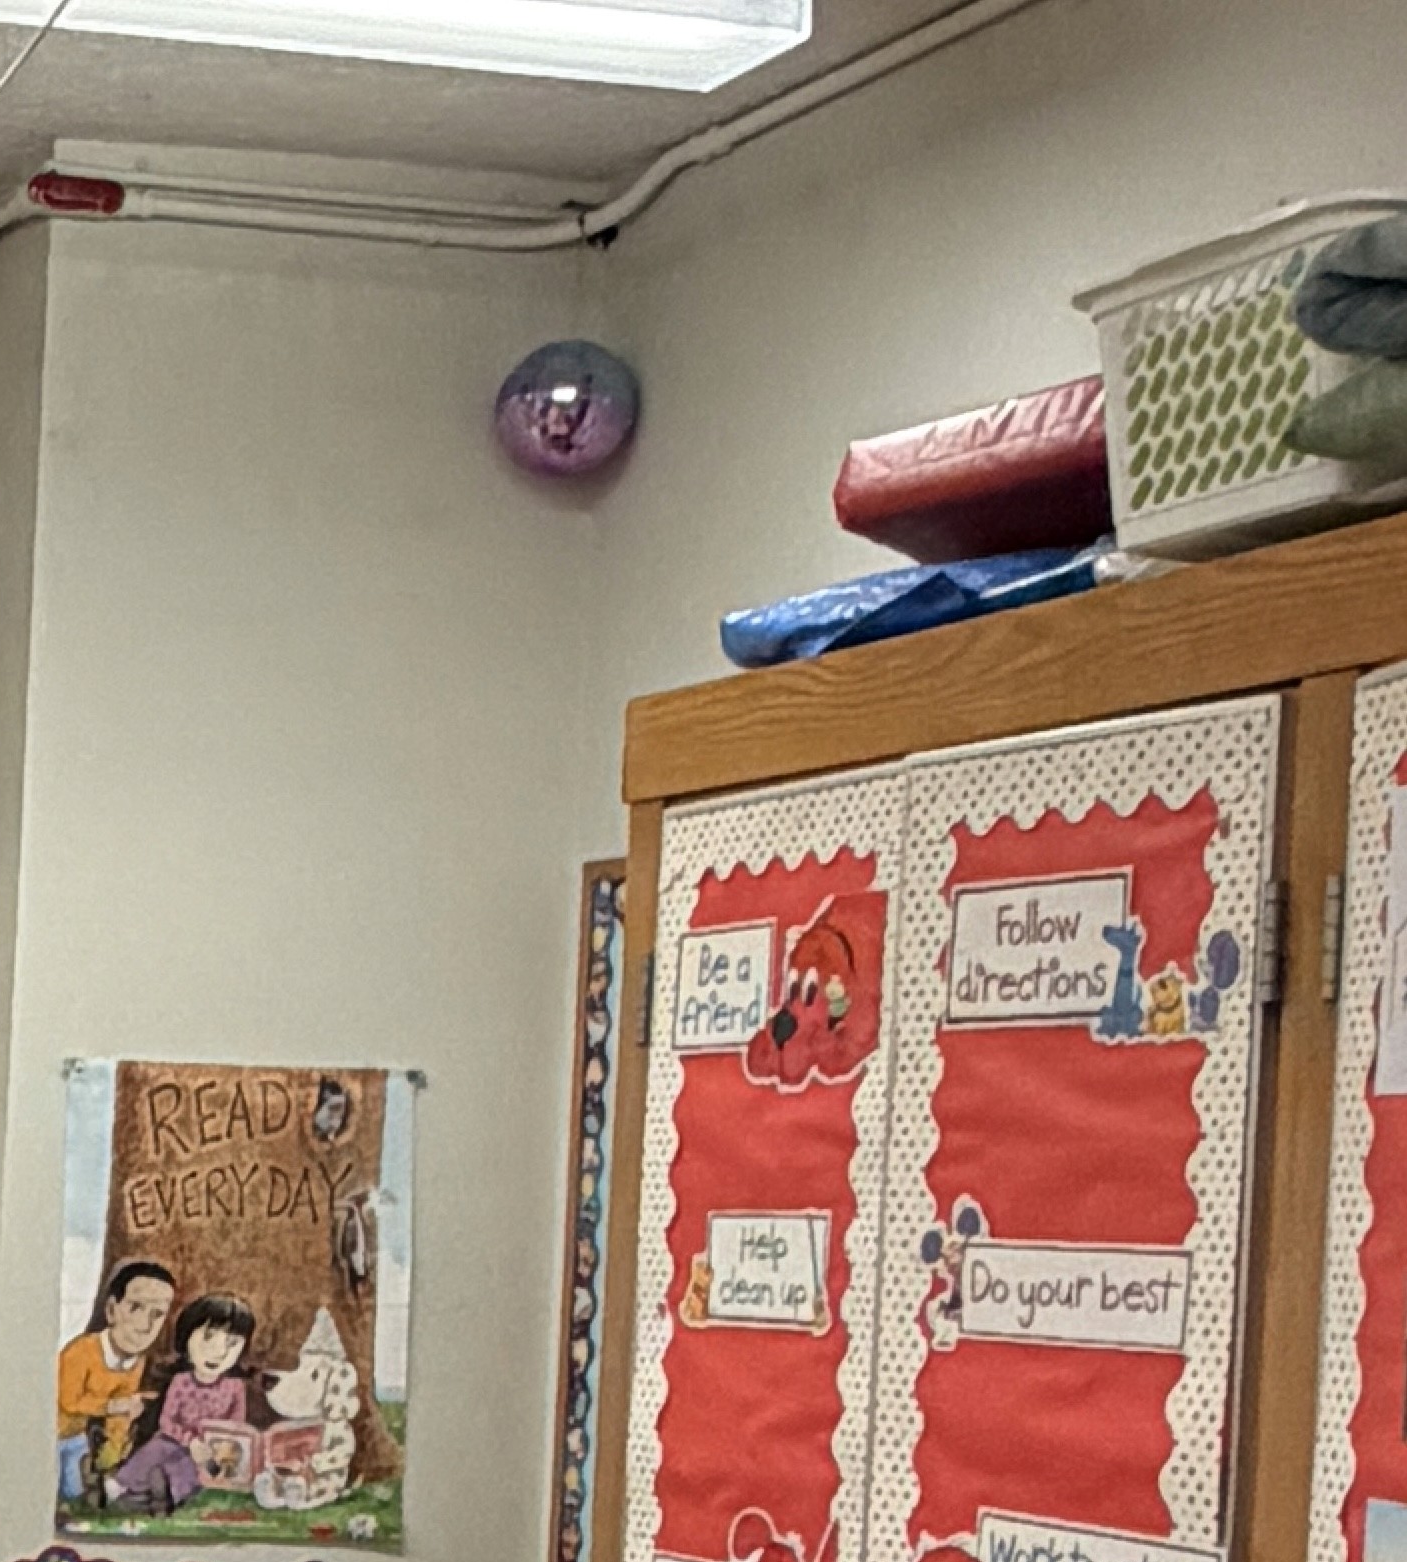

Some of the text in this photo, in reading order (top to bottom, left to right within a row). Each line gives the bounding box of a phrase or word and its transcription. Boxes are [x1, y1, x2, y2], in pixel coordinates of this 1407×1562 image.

[995, 899, 1083, 947] Follow
[696, 942, 751, 988] Be a
[955, 955, 1108, 1004] directions
[681, 984, 761, 1036] friend
[146, 1078, 292, 1157] READ
[739, 1223, 789, 1273] Help
[719, 1265, 775, 1309] clean
[970, 1259, 1183, 1328] Do your best
